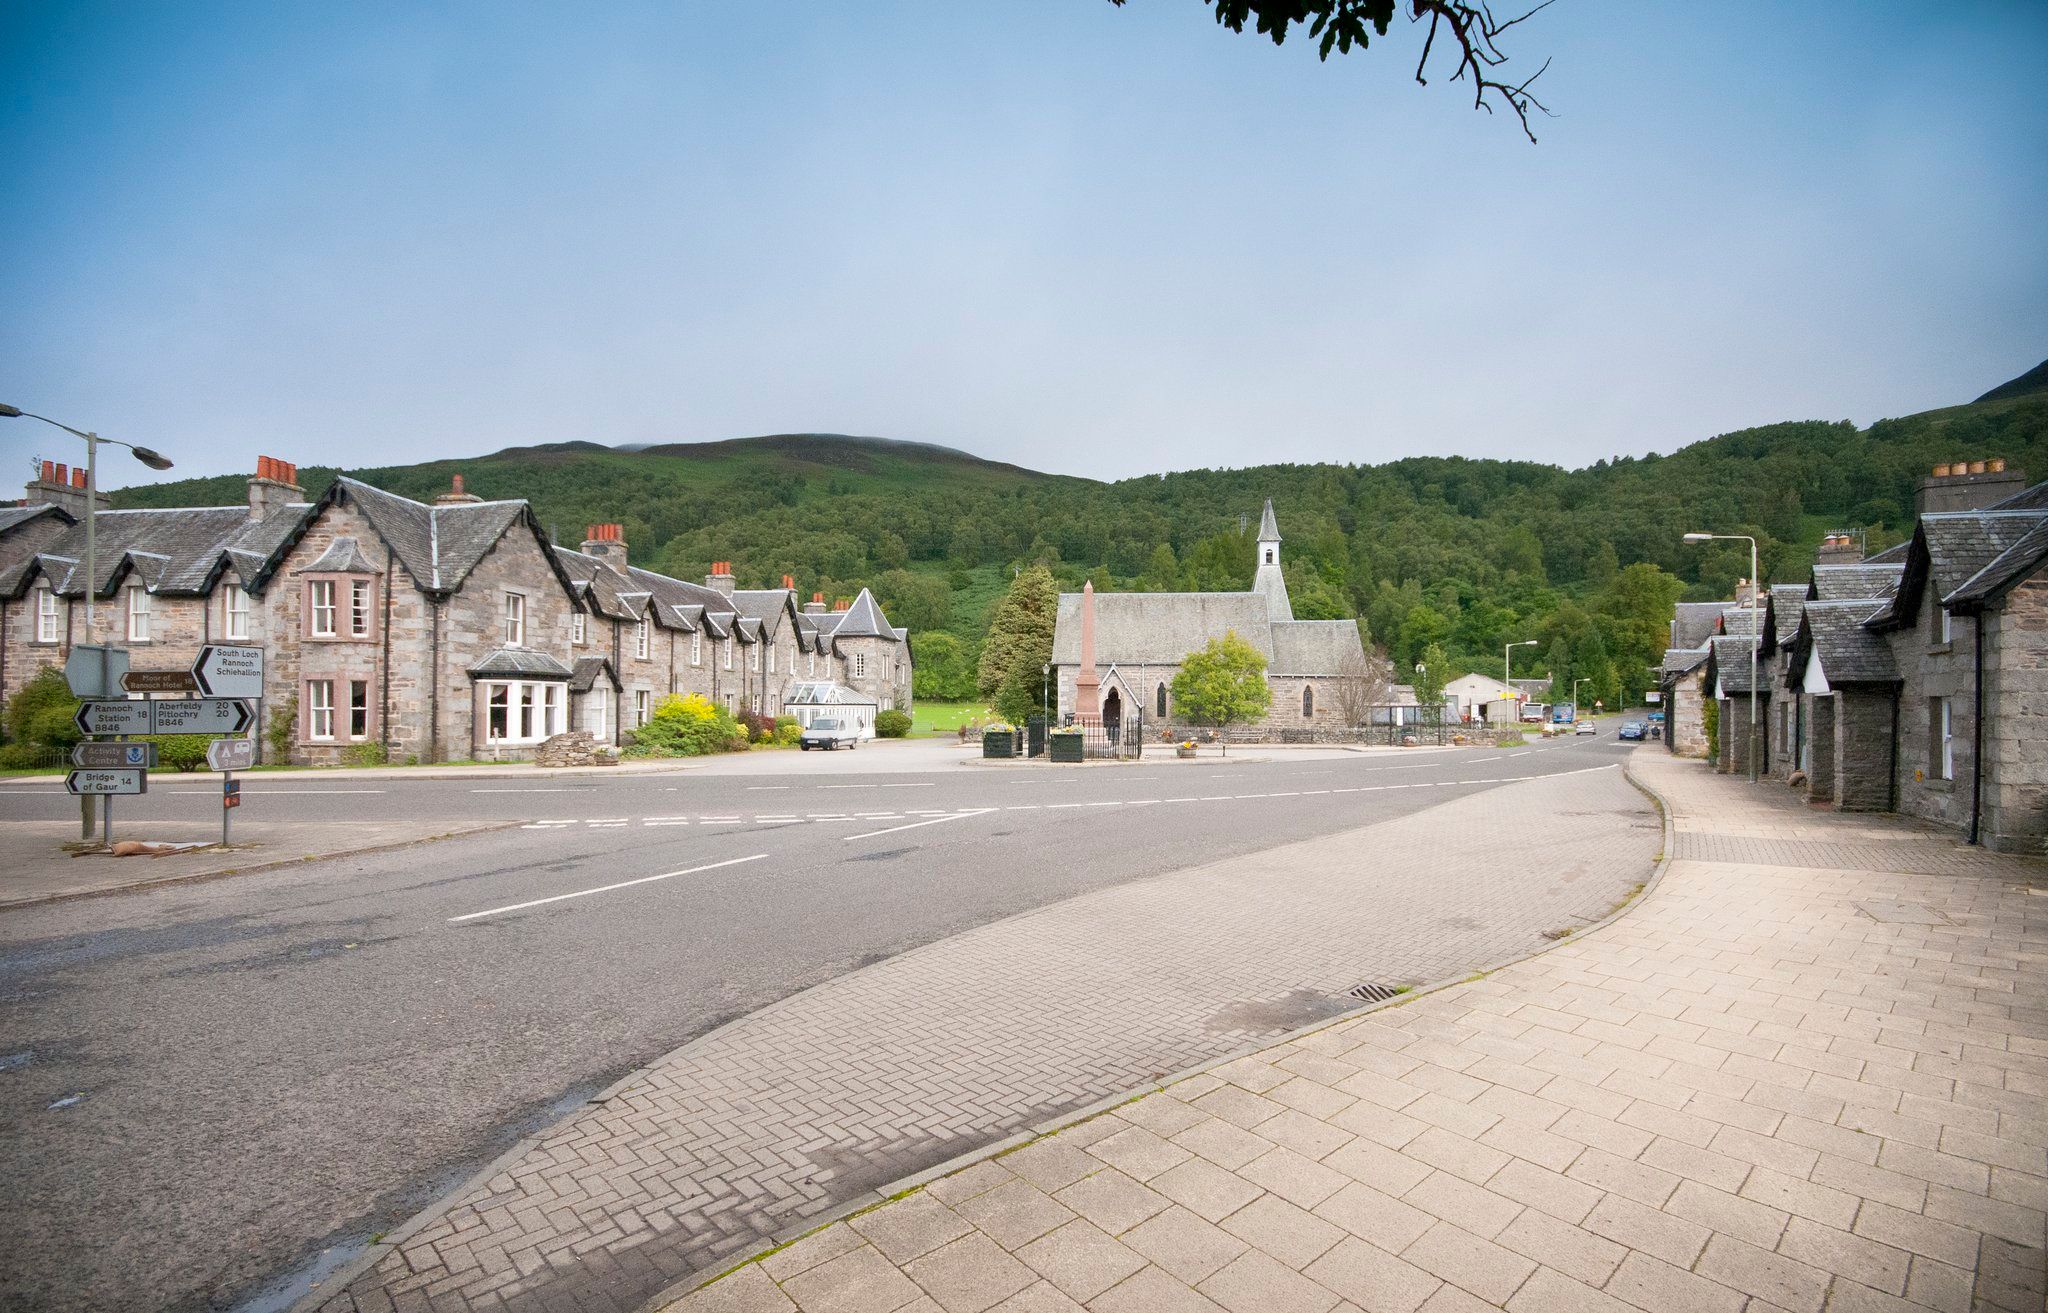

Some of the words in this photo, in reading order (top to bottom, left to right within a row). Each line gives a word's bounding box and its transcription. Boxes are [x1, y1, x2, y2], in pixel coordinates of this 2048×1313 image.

[217, 648, 239, 657] South
[242, 650, 258, 658] Loch
[222, 659, 254, 667] Rannoch
[216, 668, 260, 676] Schiehallion
[158, 702, 202, 712] Aberfeldy
[158, 710, 198, 720] Pitlochry
[88, 747, 120, 756] Activity
[86, 774, 114, 782] Bridge
[83, 782, 92, 790] of
